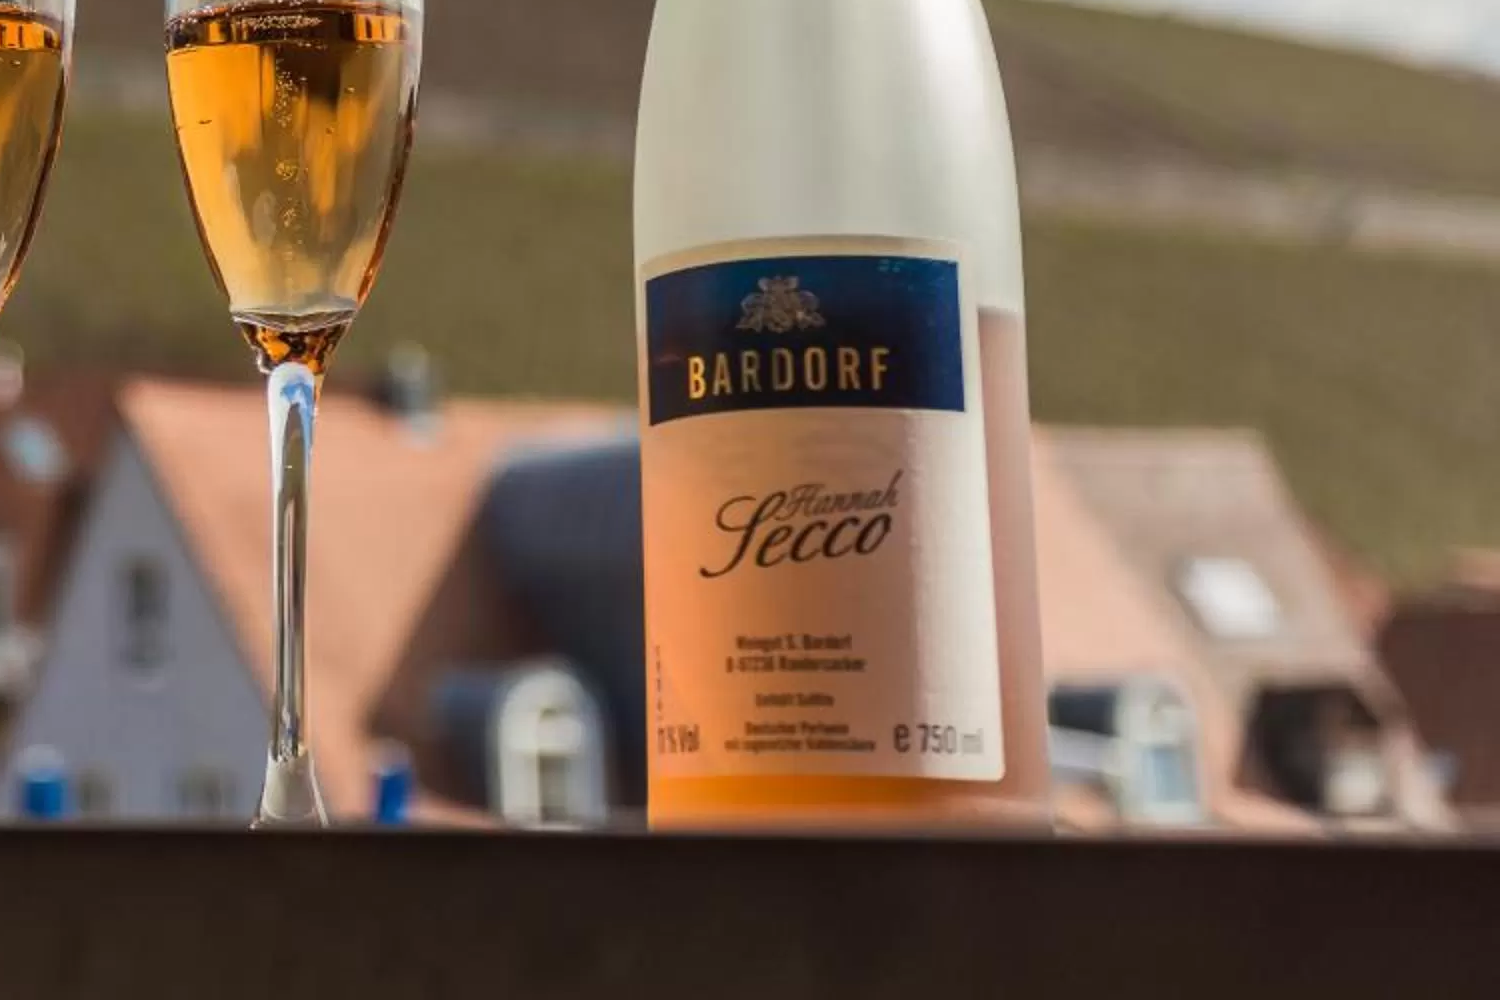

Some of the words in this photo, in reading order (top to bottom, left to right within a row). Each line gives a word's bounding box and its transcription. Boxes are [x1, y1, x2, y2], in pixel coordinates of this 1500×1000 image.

[687, 346, 890, 399] BARDORF
[774, 468, 904, 520] Hannah
[700, 491, 893, 578] Secco
[916, 723, 957, 754] 750
